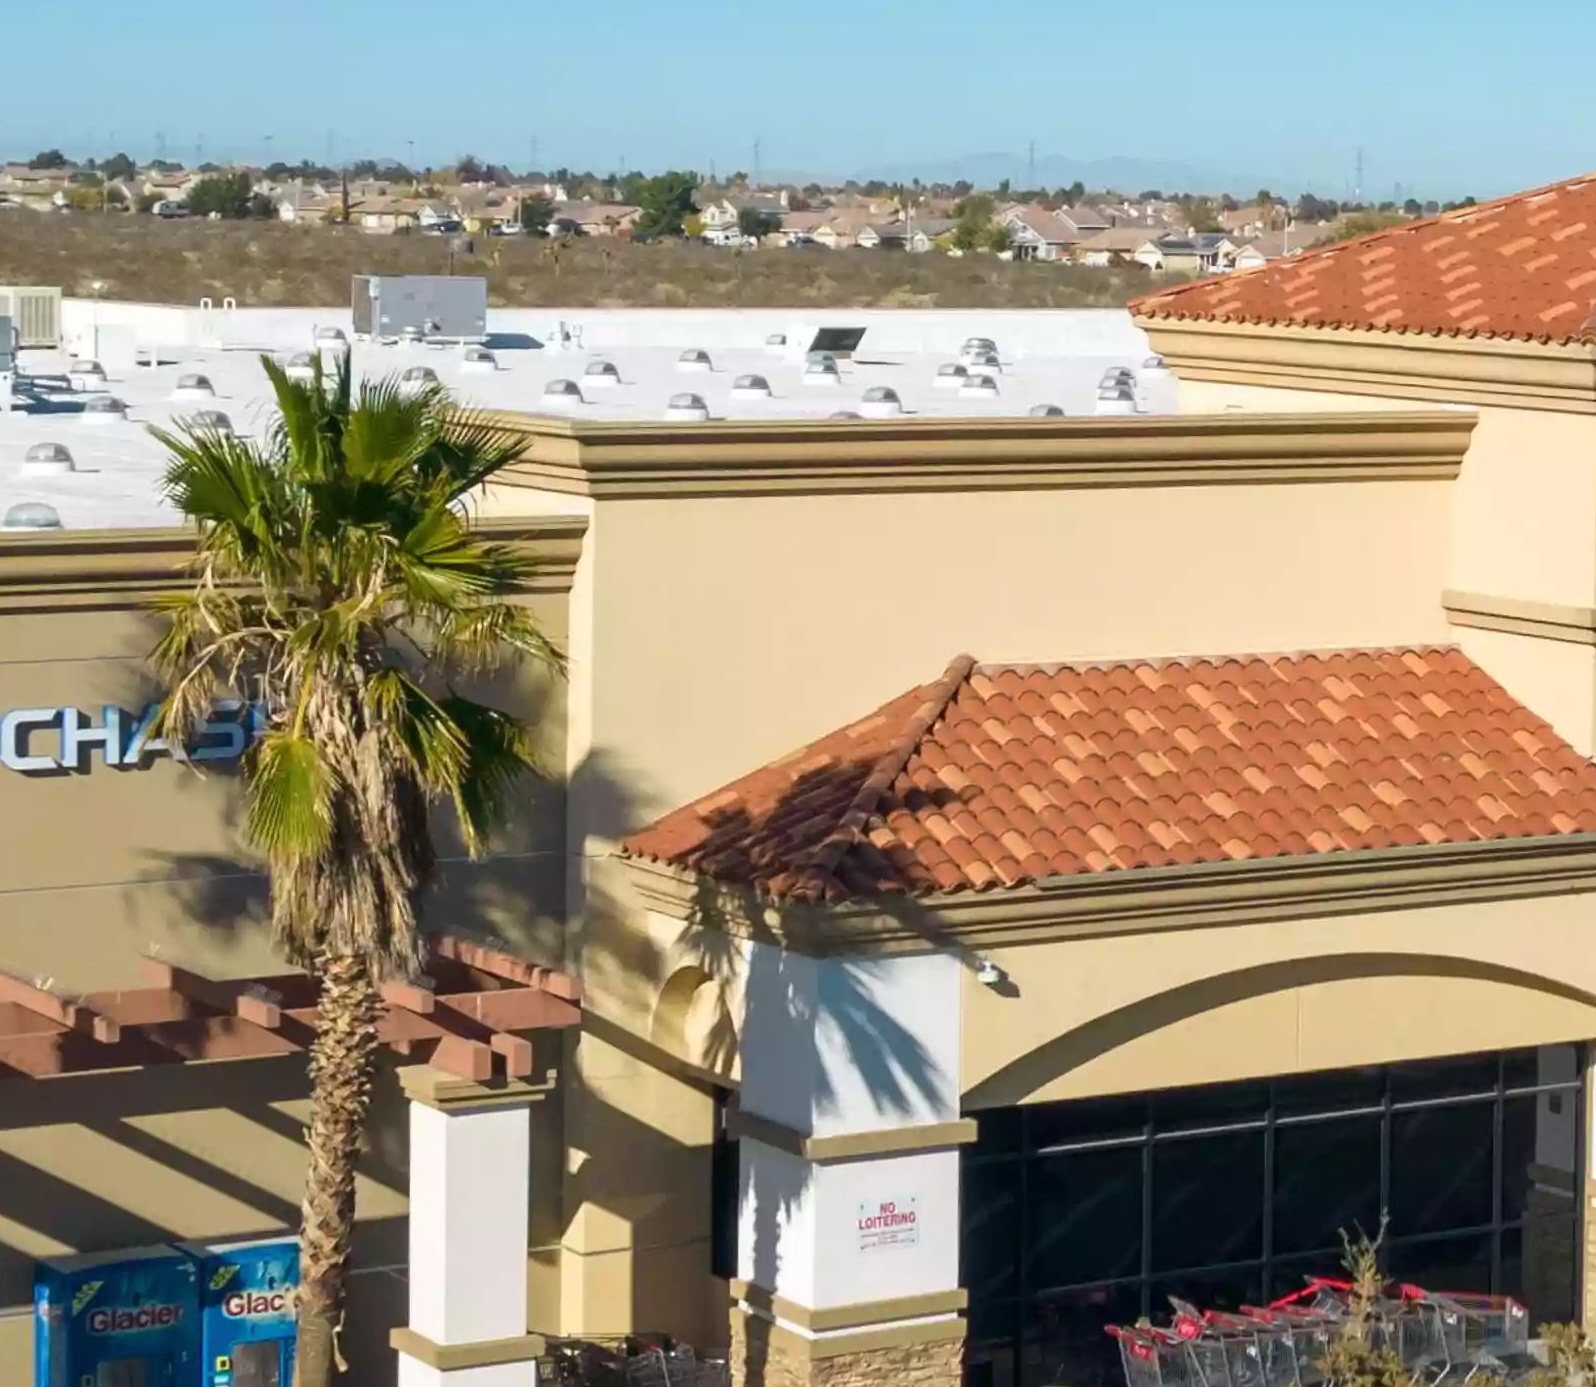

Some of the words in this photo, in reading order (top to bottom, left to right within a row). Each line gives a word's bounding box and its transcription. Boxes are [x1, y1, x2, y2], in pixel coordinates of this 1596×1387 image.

[879, 1201, 896, 1215] NO
[858, 1211, 916, 1231] LOITERING
[224, 1287, 297, 1317] Glac
[88, 1304, 182, 1332] Glacier
